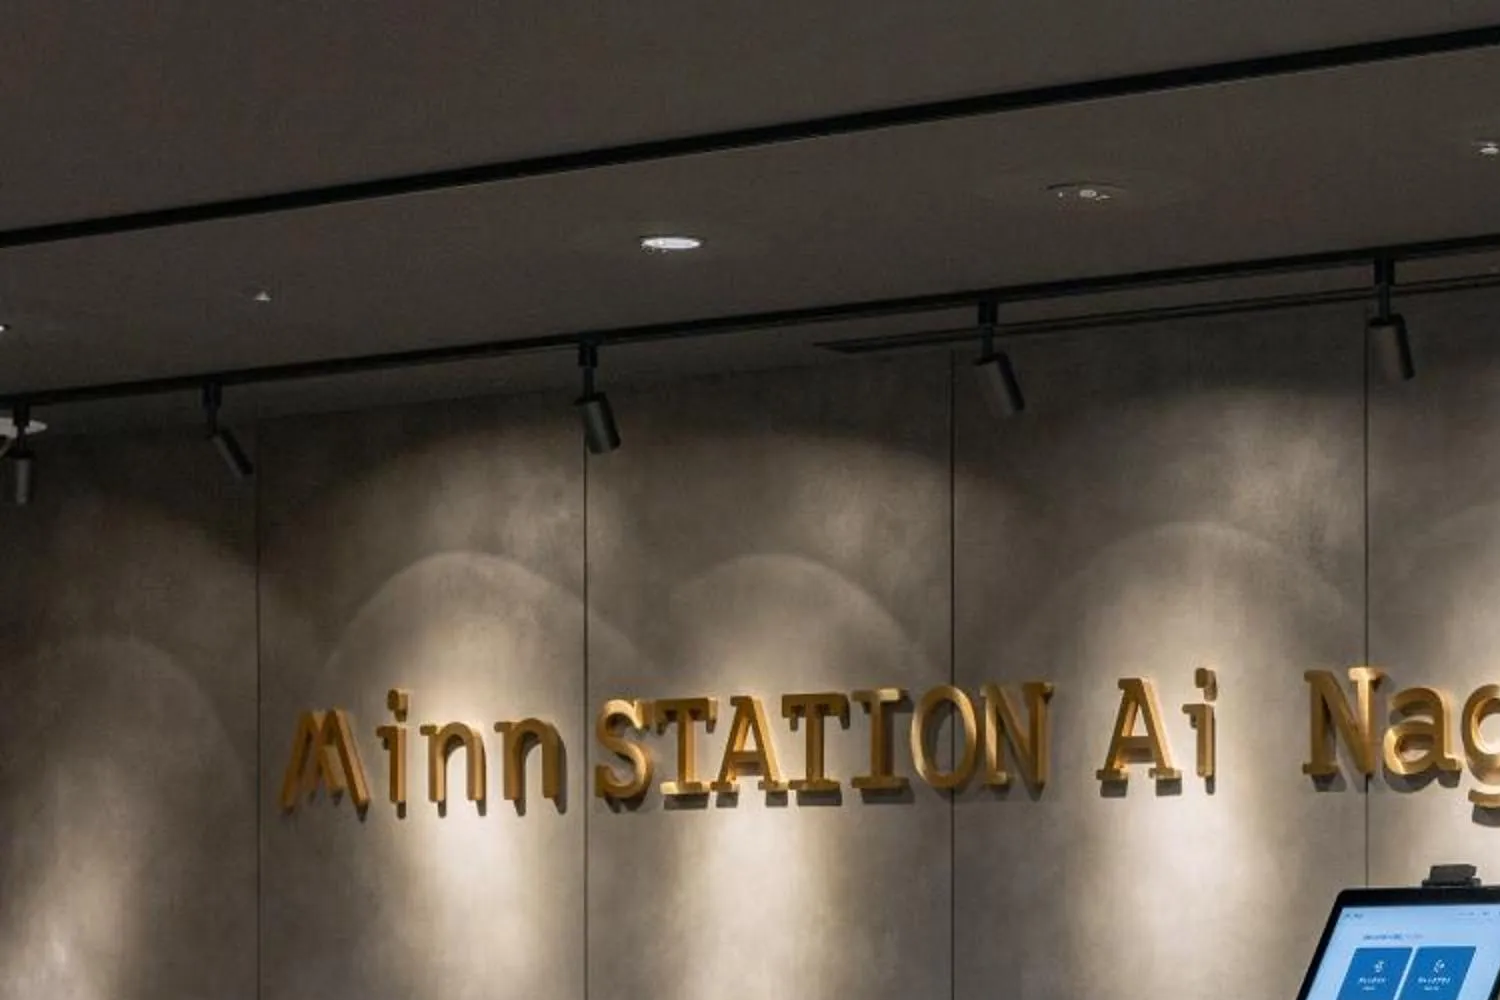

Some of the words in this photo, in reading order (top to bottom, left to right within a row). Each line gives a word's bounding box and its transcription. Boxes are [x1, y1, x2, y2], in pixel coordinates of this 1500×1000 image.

[281, 688, 565, 815] Minn
[595, 681, 1056, 800] STATION
[1097, 667, 1218, 782] Ai
